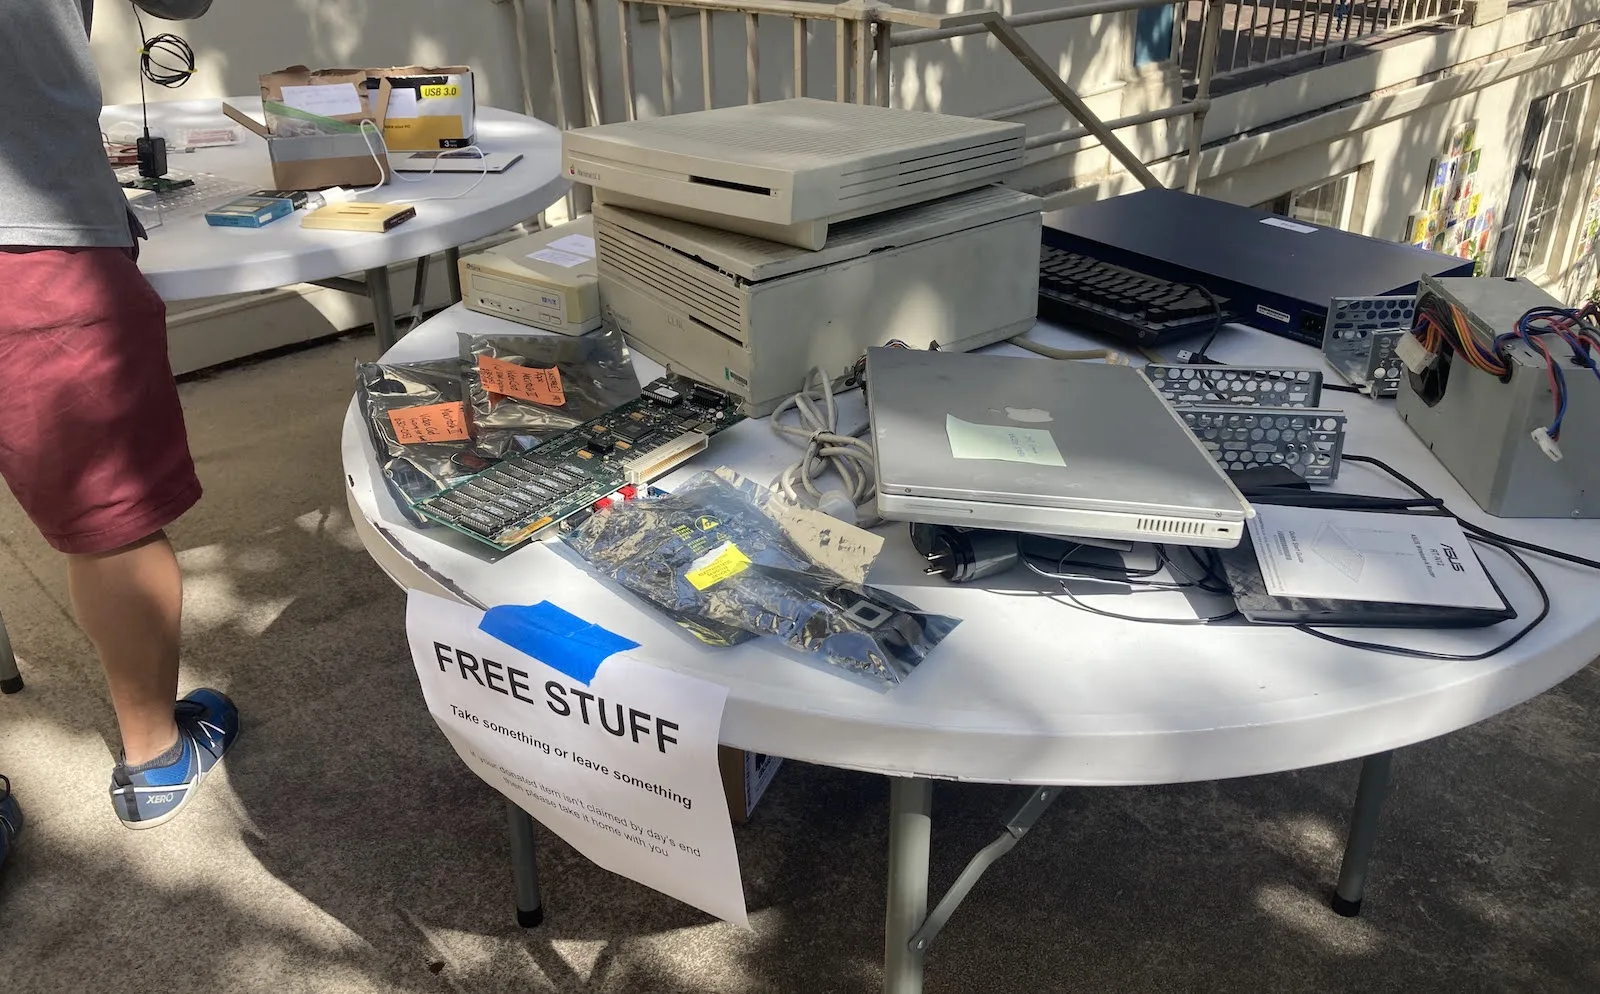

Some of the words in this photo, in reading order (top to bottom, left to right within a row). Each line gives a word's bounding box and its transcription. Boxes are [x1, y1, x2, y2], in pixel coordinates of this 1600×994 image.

[424, 87, 442, 97] USB
[443, 87, 457, 96] 3.0
[1440, 543, 1465, 572] ASUS
[433, 641, 534, 705] FREE
[545, 680, 679, 753] STUFF
[450, 704, 479, 724] Take
[482, 719, 550, 754] something
[554, 747, 568, 759] or
[572, 752, 609, 775] leave
[613, 770, 692, 810] something
[146, 792, 174, 805] XERO
[500, 765, 538, 789] donated
[539, 783, 561, 799] item
[562, 792, 585, 809] isn't
[586, 803, 628, 827] claimed
[629, 820, 644, 835] by
[646, 827, 676, 847] day's
[679, 842, 701, 857] end
[525, 788, 557, 808] please
[558, 803, 580, 819] take
[582, 814, 590, 823] it
[591, 816, 622, 837] home
[623, 831, 646, 848] with
[648, 841, 669, 857] you
